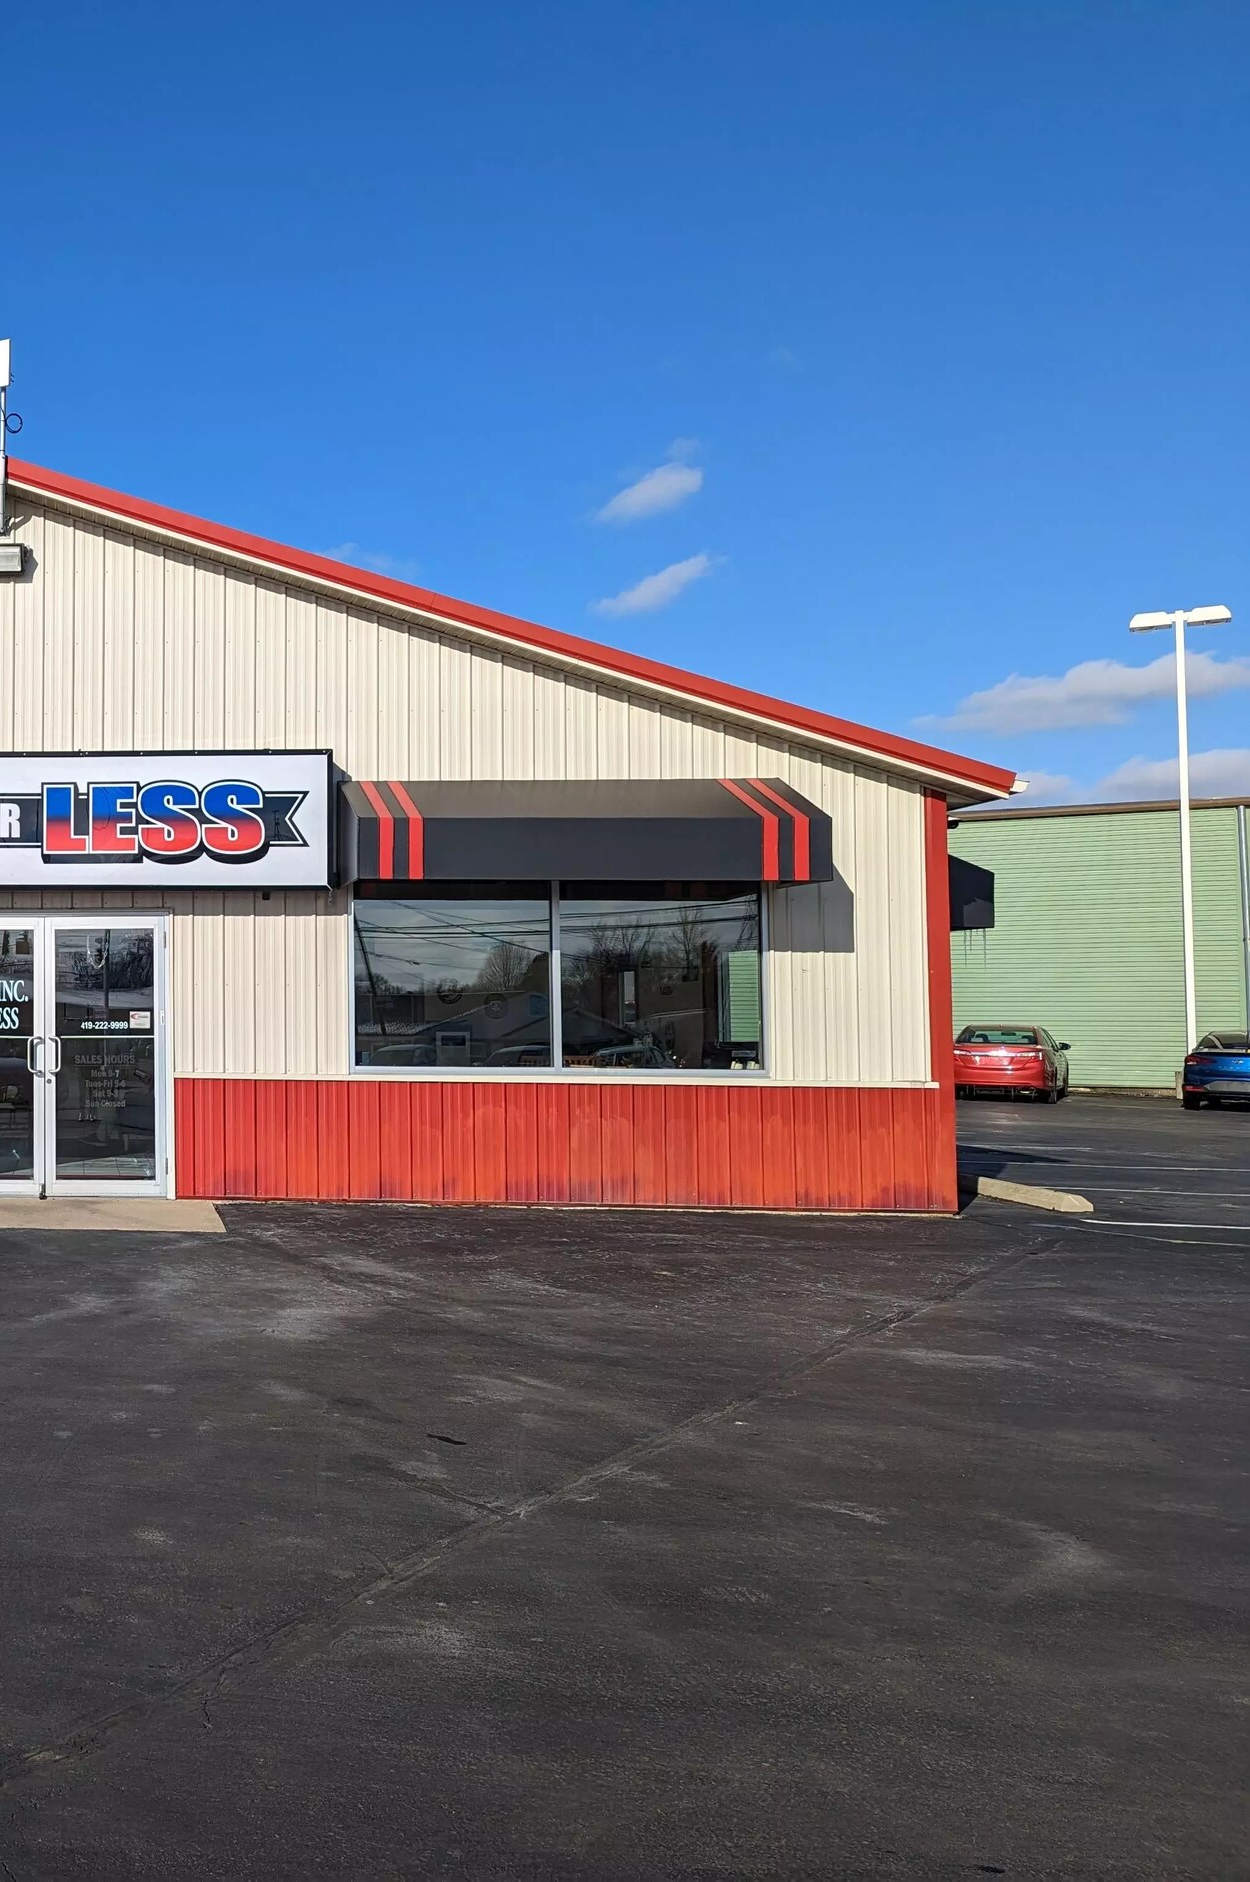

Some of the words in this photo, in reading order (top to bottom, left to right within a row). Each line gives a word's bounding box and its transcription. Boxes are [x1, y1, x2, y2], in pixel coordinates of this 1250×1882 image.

[40, 779, 269, 864] LESS
[80, 1021, 129, 1030] 419-222-9999
[74, 1054, 103, 1064] SALES
[104, 1054, 136, 1064] HOURS
[91, 1069, 107, 1078] Mon
[107, 1069, 120, 1078] 9-7
[85, 1079, 113, 1088] Tues-Fri
[92, 1089, 106, 1098] Sat
[85, 1099, 100, 1108] Sun
[101, 1099, 126, 1108] Closed
